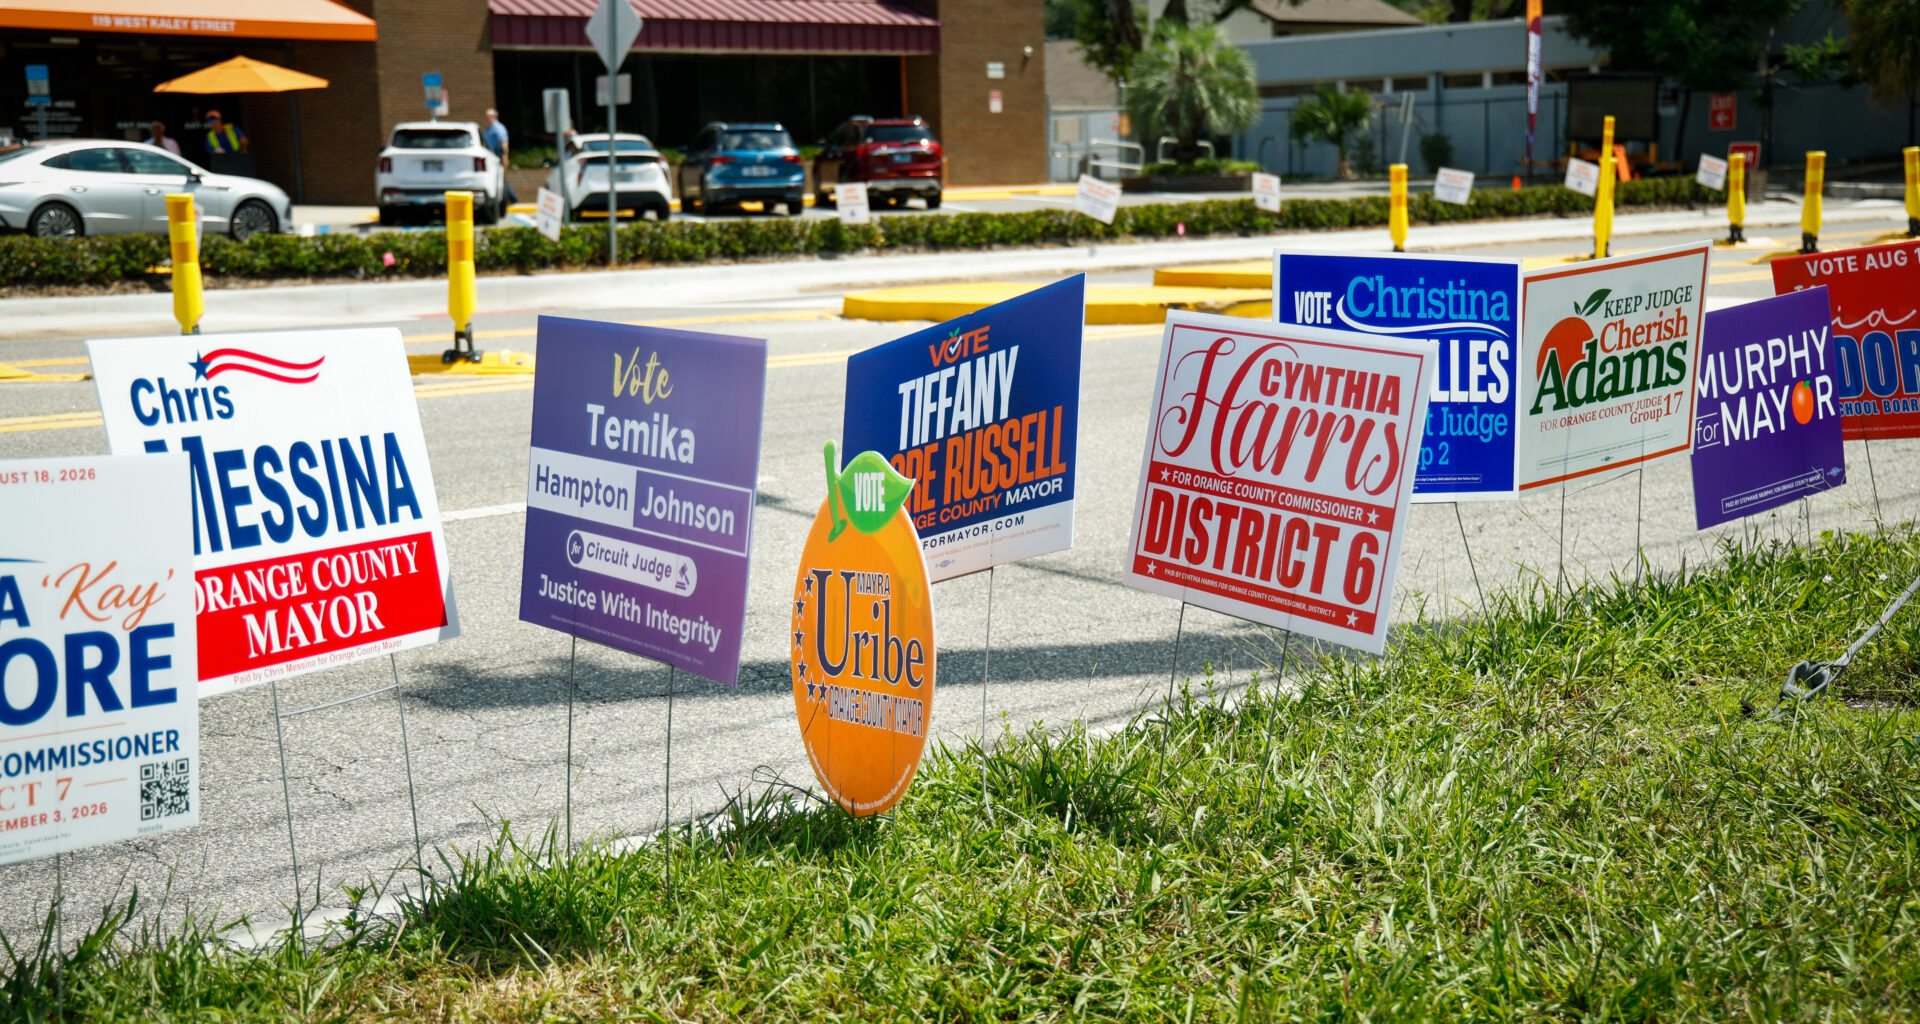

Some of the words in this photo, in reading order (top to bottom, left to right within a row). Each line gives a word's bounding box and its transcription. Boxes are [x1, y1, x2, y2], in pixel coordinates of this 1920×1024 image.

[92, 15, 111, 26] 119
[113, 16, 147, 28] WEST
[150, 18, 188, 30] KALEY
[191, 19, 236, 32] STREET
[1805, 255, 1859, 277] VOTE
[1865, 249, 1908, 271] AUG
[1294, 291, 1332, 324] VOTE
[1346, 275, 1511, 322] Christina
[1604, 294, 1643, 319] KEEP
[1645, 285, 1693, 311] JUDGE
[929, 325, 991, 368] VOTE
[1600, 306, 1689, 354] Cherish
[613, 346, 674, 405] Vote
[1529, 339, 1688, 416] Adams
[1699, 326, 1829, 399] MURPHY
[130, 377, 235, 426] Chris
[898, 344, 1020, 451] TIFFANY
[1259, 358, 1400, 416] CYNTHIA
[1629, 407, 1663, 425] Group
[1663, 391, 1684, 417] 17
[586, 403, 696, 464] Temika
[1159, 336, 1400, 496] Harris
[1439, 405, 1508, 443] Judge
[1540, 419, 1558, 432] FOR
[1559, 411, 1597, 428] ORANGE
[1598, 402, 1635, 419] COUNTY
[1636, 395, 1663, 412] JUDGE
[1696, 419, 1719, 443] for
[34, 469, 54, 484] 18,
[60, 468, 96, 482] 2026
[943, 405, 1067, 504] RUSSELL
[1438, 441, 1449, 465] 2
[143, 432, 423, 556] MESSINA
[535, 464, 629, 511] Hampton
[641, 486, 735, 536] Johnson
[854, 472, 885, 512] VOTE
[939, 493, 1003, 521] COUNTY
[1005, 477, 1063, 506] MAYOR
[1172, 470, 1192, 486] FOR
[1193, 475, 1233, 495] ORANGE
[1234, 484, 1277, 503] COUNTY
[1278, 492, 1364, 522] COMMISSIONER
[312, 541, 419, 591] COUNTY
[571, 541, 582, 556] for
[586, 541, 630, 568] Circuit
[632, 553, 672, 582] Judge
[1143, 488, 1340, 595] DISTRICT
[1342, 531, 1379, 605] 6
[856, 572, 891, 596] MAYRA
[1164, 568, 1175, 577] PAID
[1182, 573, 1201, 584] CYNTHIA
[1201, 577, 1218, 588] HARRIS
[1218, 582, 1228, 590] FOR
[1228, 584, 1248, 595] ORANGE
[1248, 589, 1268, 600] COUNTY
[1308, 604, 1331, 617] DISTRICT
[1331, 610, 1337, 618] 6
[243, 590, 385, 659] MAYOR
[539, 574, 596, 611] Justice
[601, 590, 641, 624] With
[646, 603, 722, 653] Integrity
[811, 568, 924, 688] Uribe
[233, 673, 251, 685] Paid
[252, 670, 262, 683] by
[264, 666, 284, 678] Chris
[286, 659, 316, 674] Messina
[317, 656, 327, 667] for
[329, 651, 355, 667] Orange
[356, 645, 381, 659] County
[382, 638, 403, 652] Mayor
[828, 685, 860, 725] ORANGE
[861, 690, 893, 731] COUNTY
[894, 696, 924, 738] MAYOR
[0, 729, 180, 778] OMMISSIONER
[54, 810, 67, 823] 3,
[72, 802, 108, 820] 2026
[56, 777, 73, 801] 7
